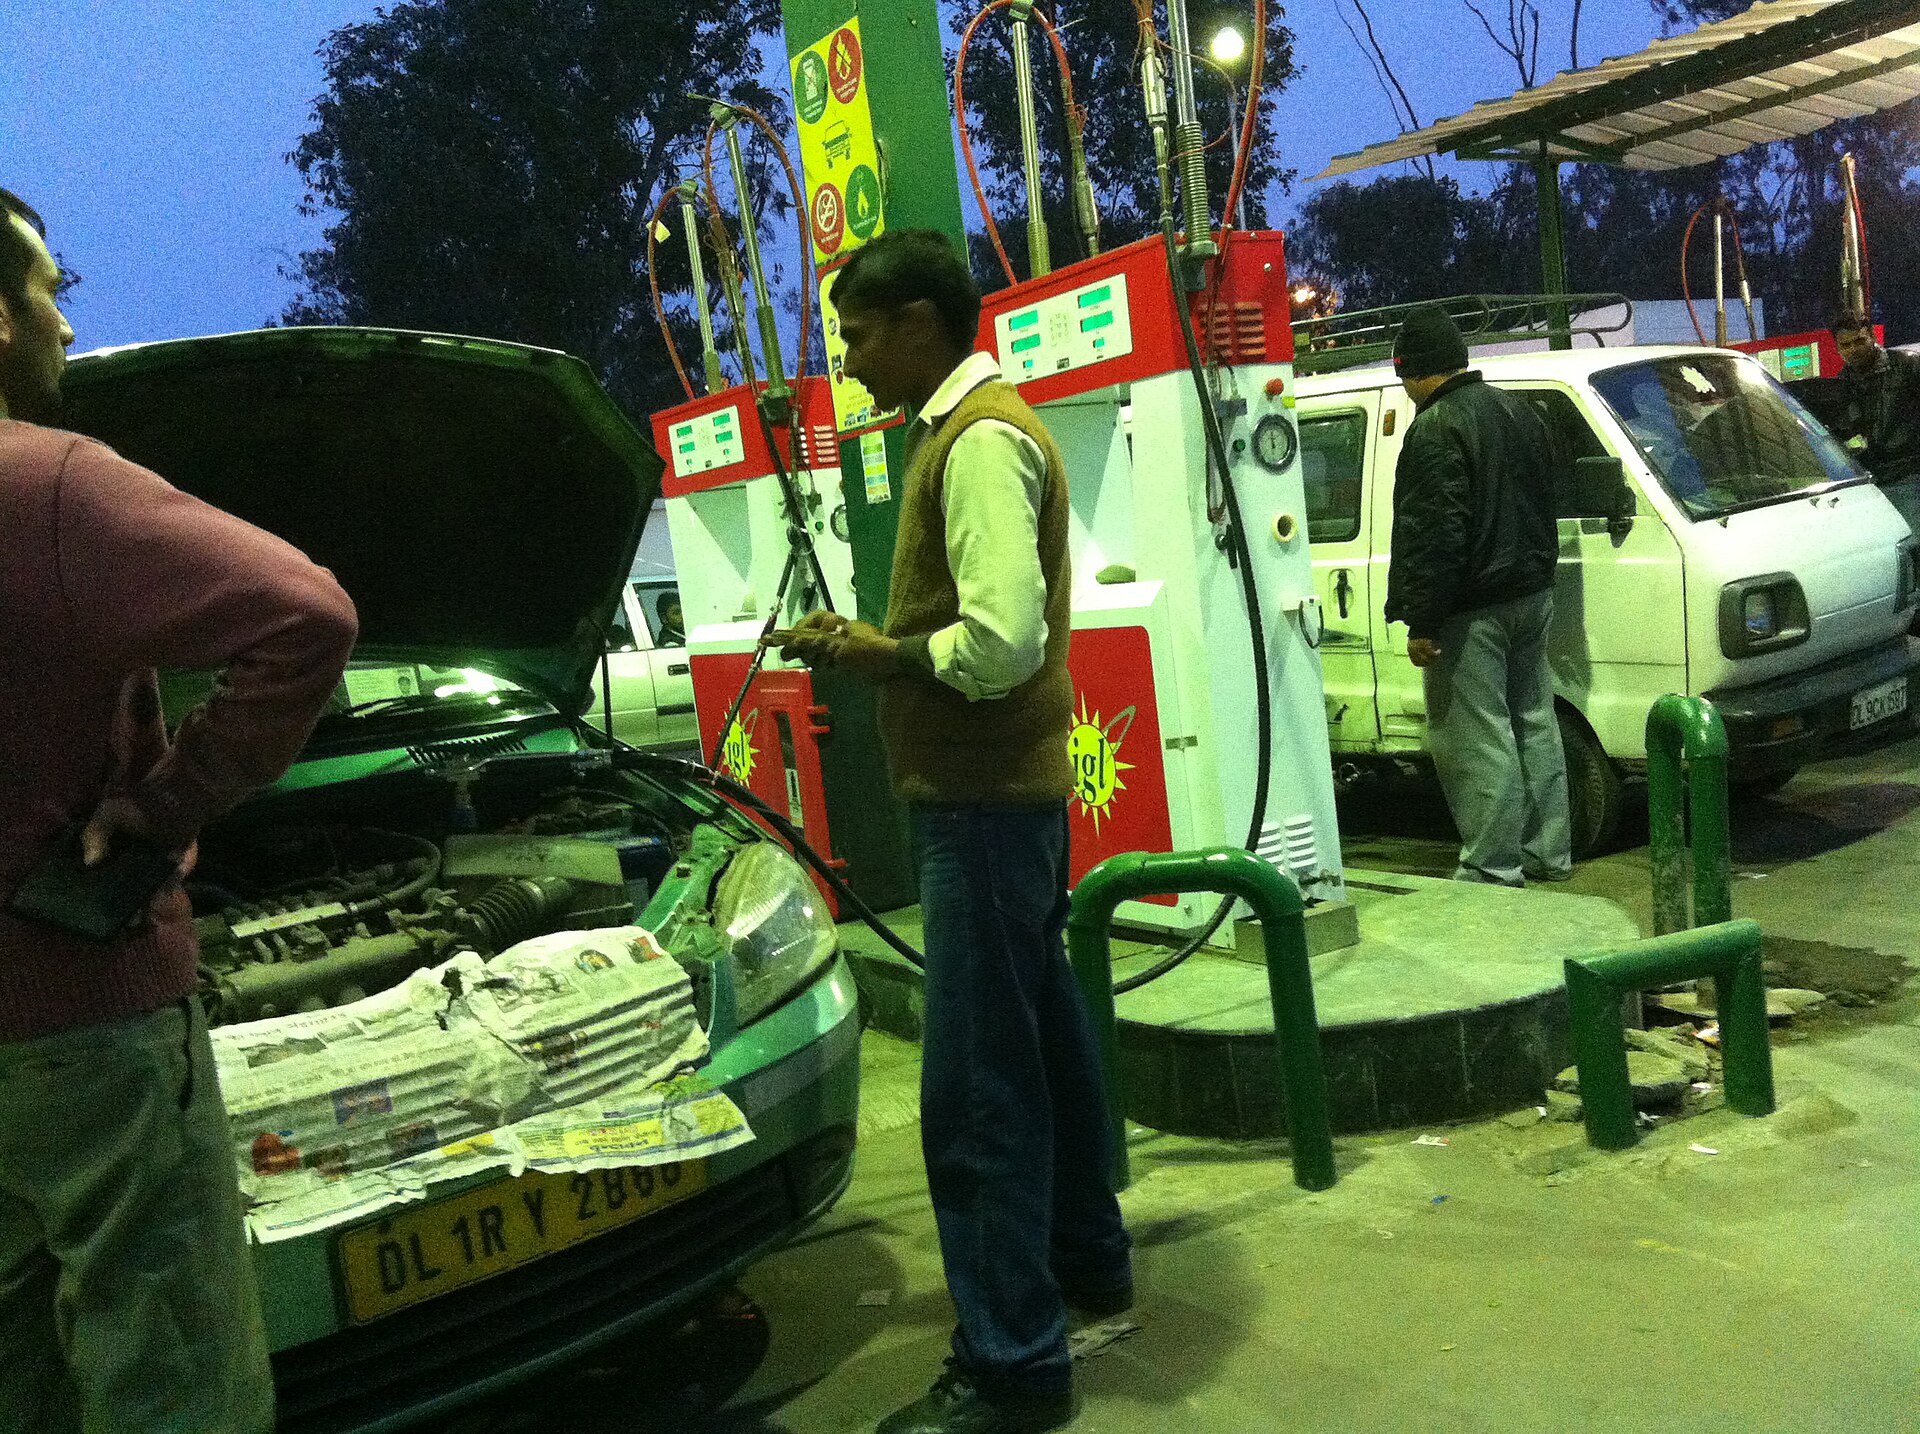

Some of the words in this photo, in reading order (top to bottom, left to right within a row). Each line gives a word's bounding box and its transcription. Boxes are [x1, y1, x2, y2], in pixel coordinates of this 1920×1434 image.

[726, 730, 746, 777] igl
[1072, 736, 1105, 803] igl
[377, 1231, 442, 1294] DL
[452, 1204, 507, 1265] 1R
[523, 1187, 546, 1238] Y
